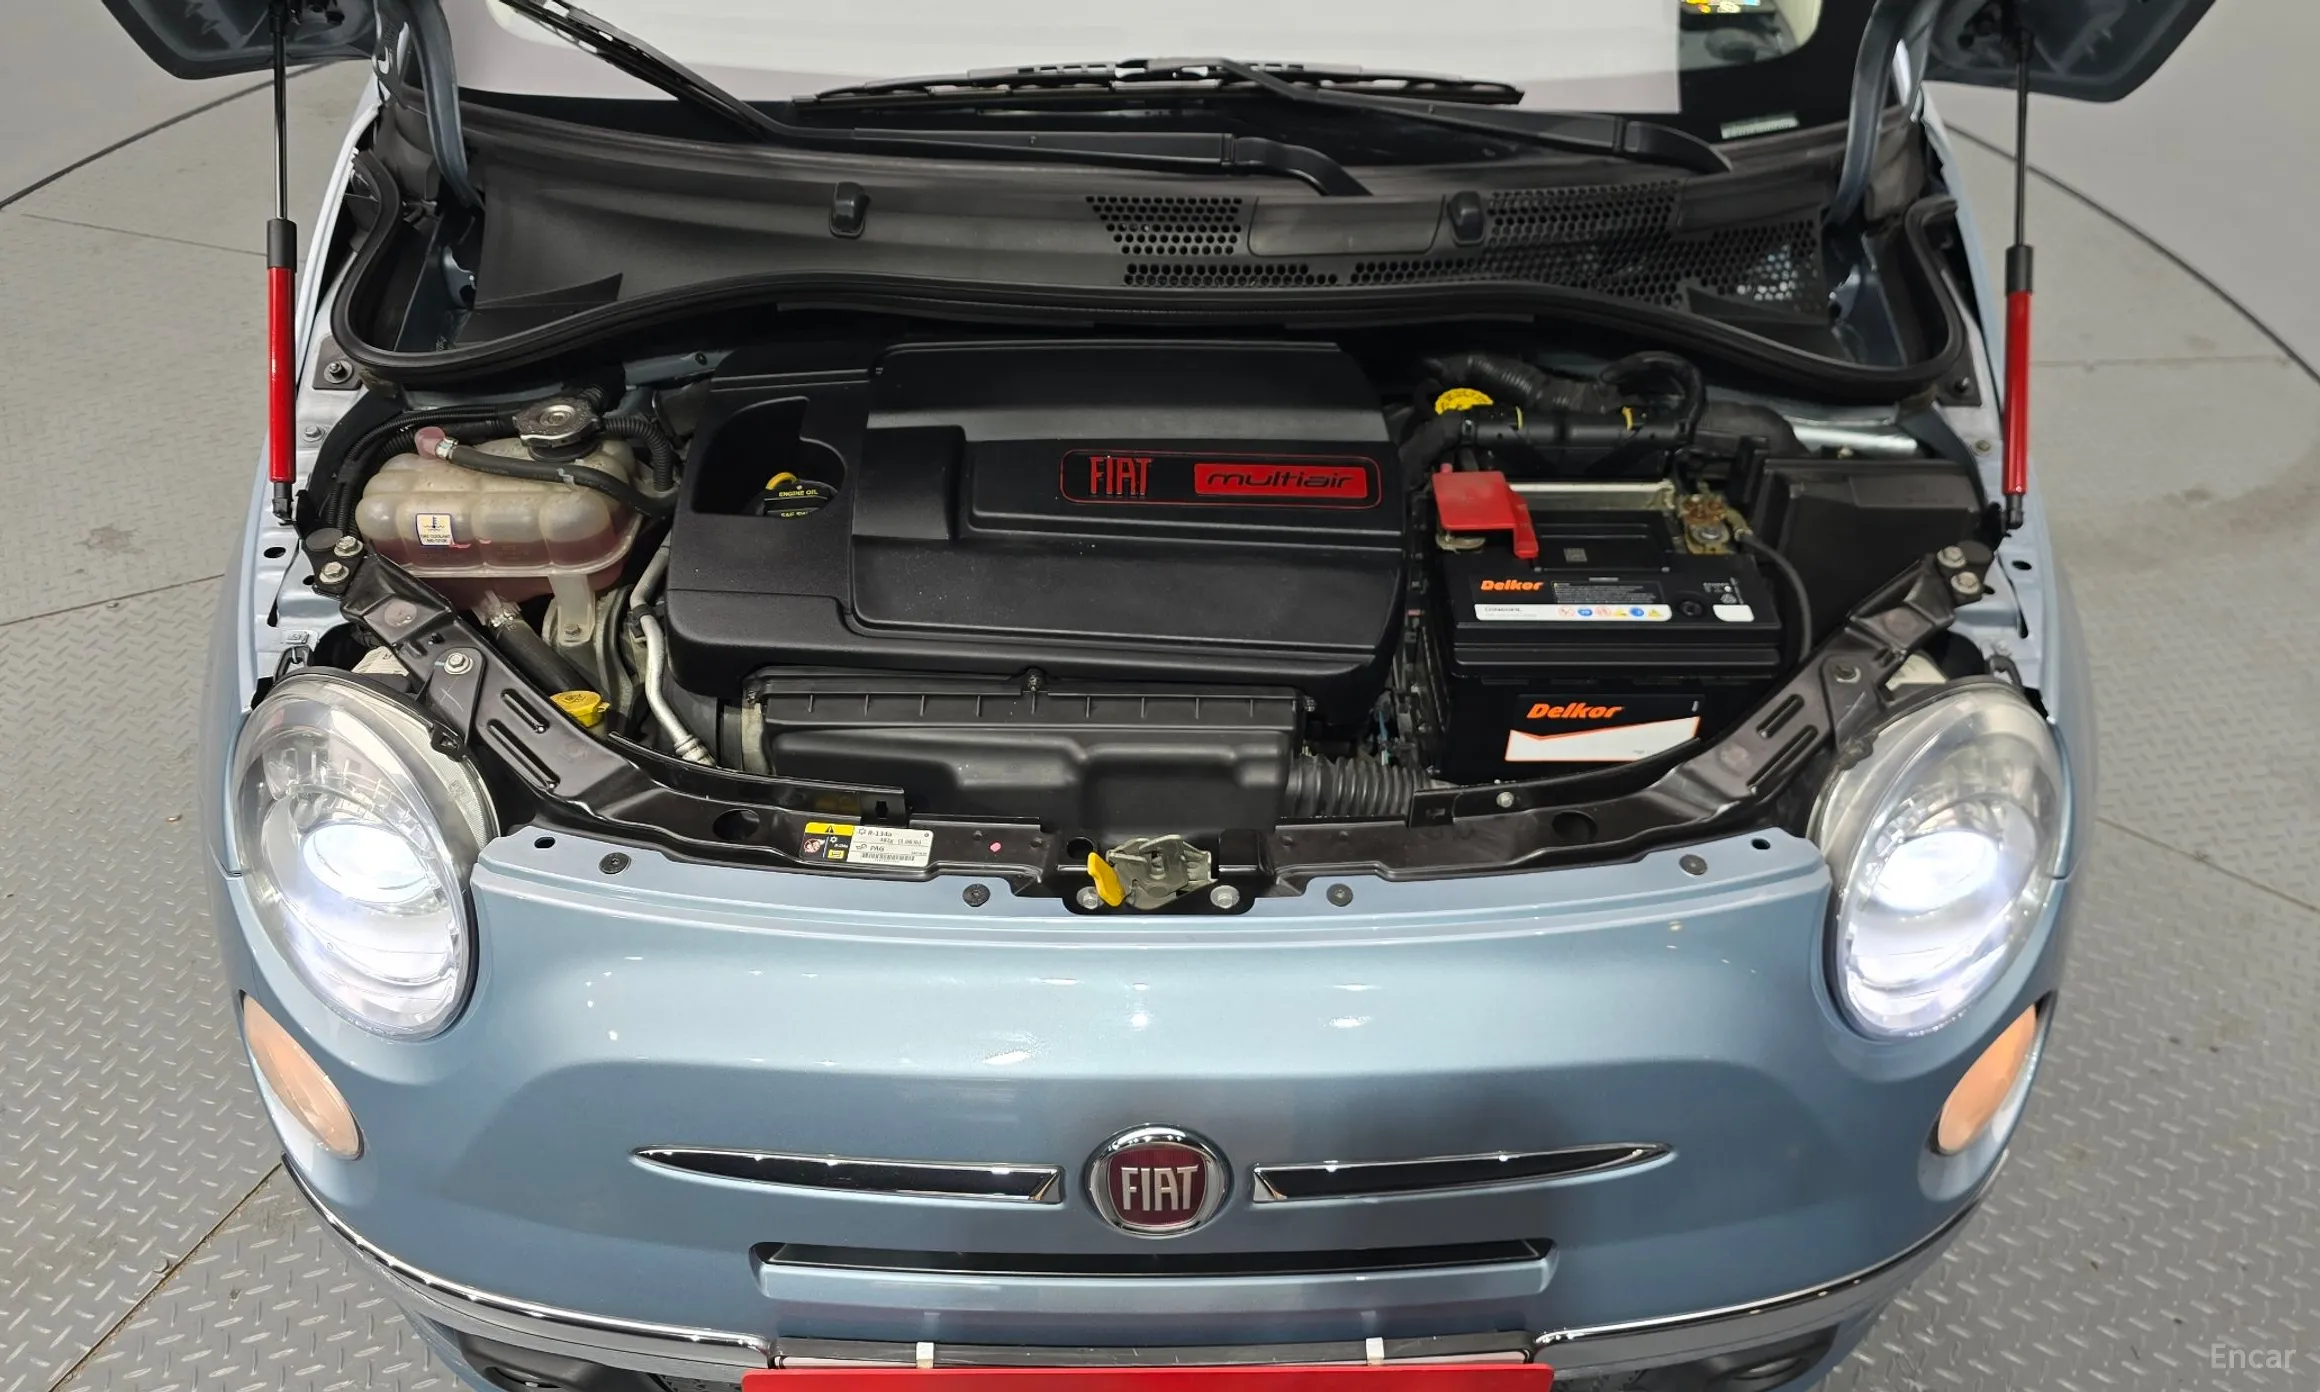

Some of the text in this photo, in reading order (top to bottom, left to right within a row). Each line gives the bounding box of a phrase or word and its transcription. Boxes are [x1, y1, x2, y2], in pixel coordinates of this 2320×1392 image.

[1089, 456, 1353, 496] FIAT multiair
[1480, 580, 1544, 591] Delkor
[1527, 703, 1625, 719] Delkor
[1121, 1164, 1199, 1211] FIAT
